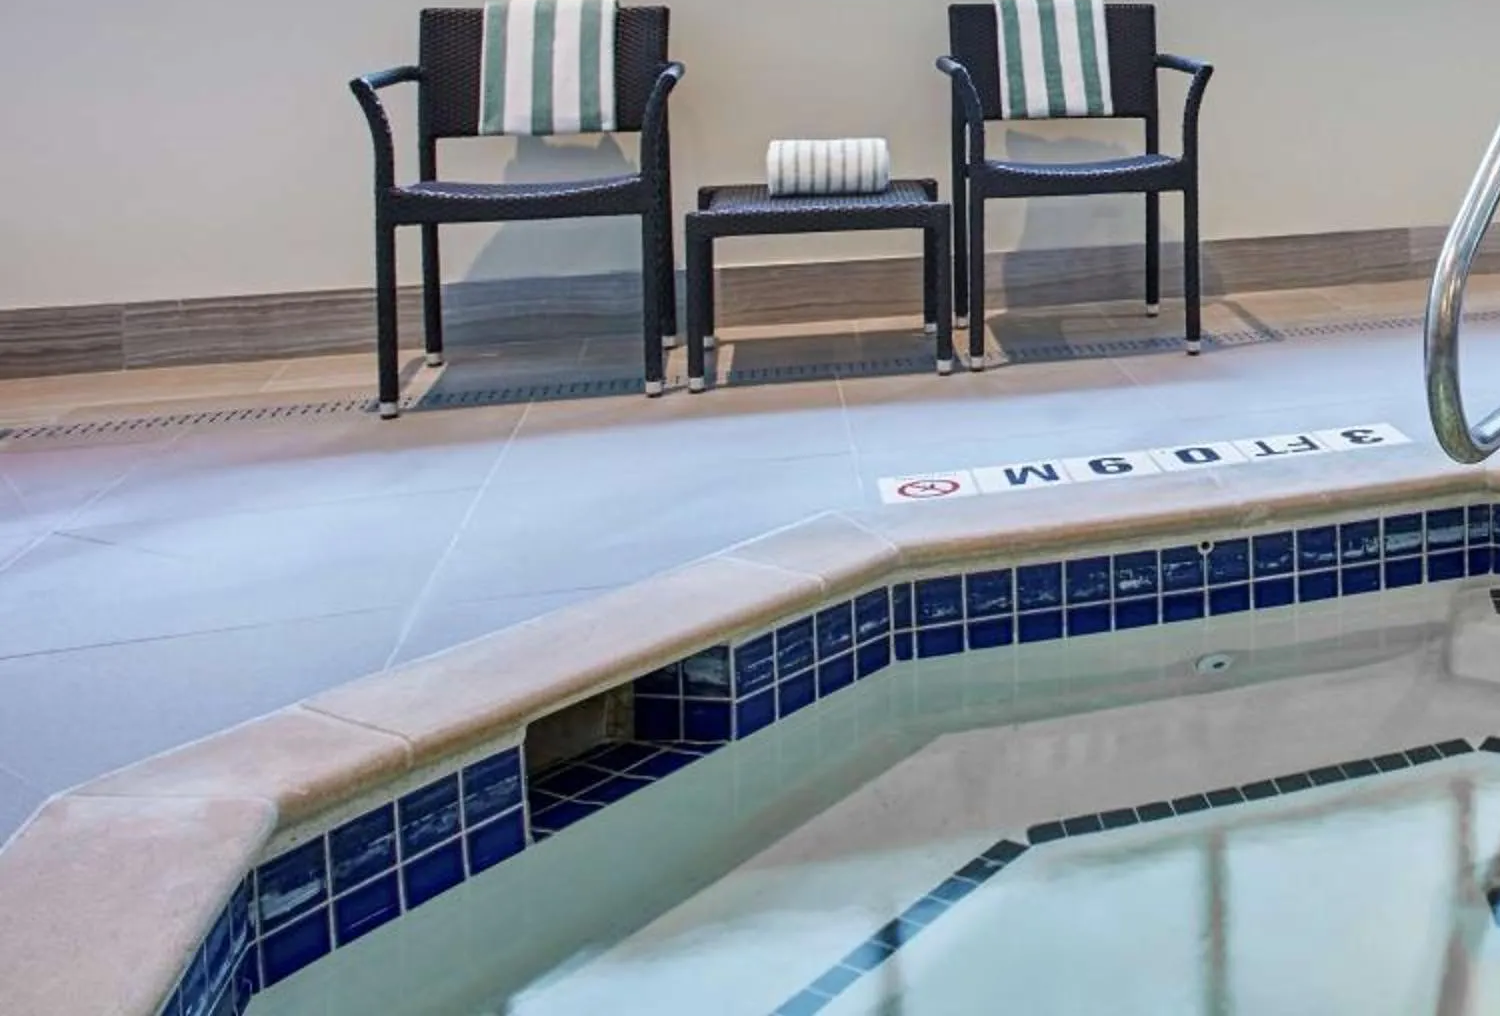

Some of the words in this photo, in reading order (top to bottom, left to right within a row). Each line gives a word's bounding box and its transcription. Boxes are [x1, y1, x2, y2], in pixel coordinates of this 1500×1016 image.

[1254, 435, 1321, 457] FT
[1340, 429, 1384, 445] 3
[1003, 463, 1061, 486] M
